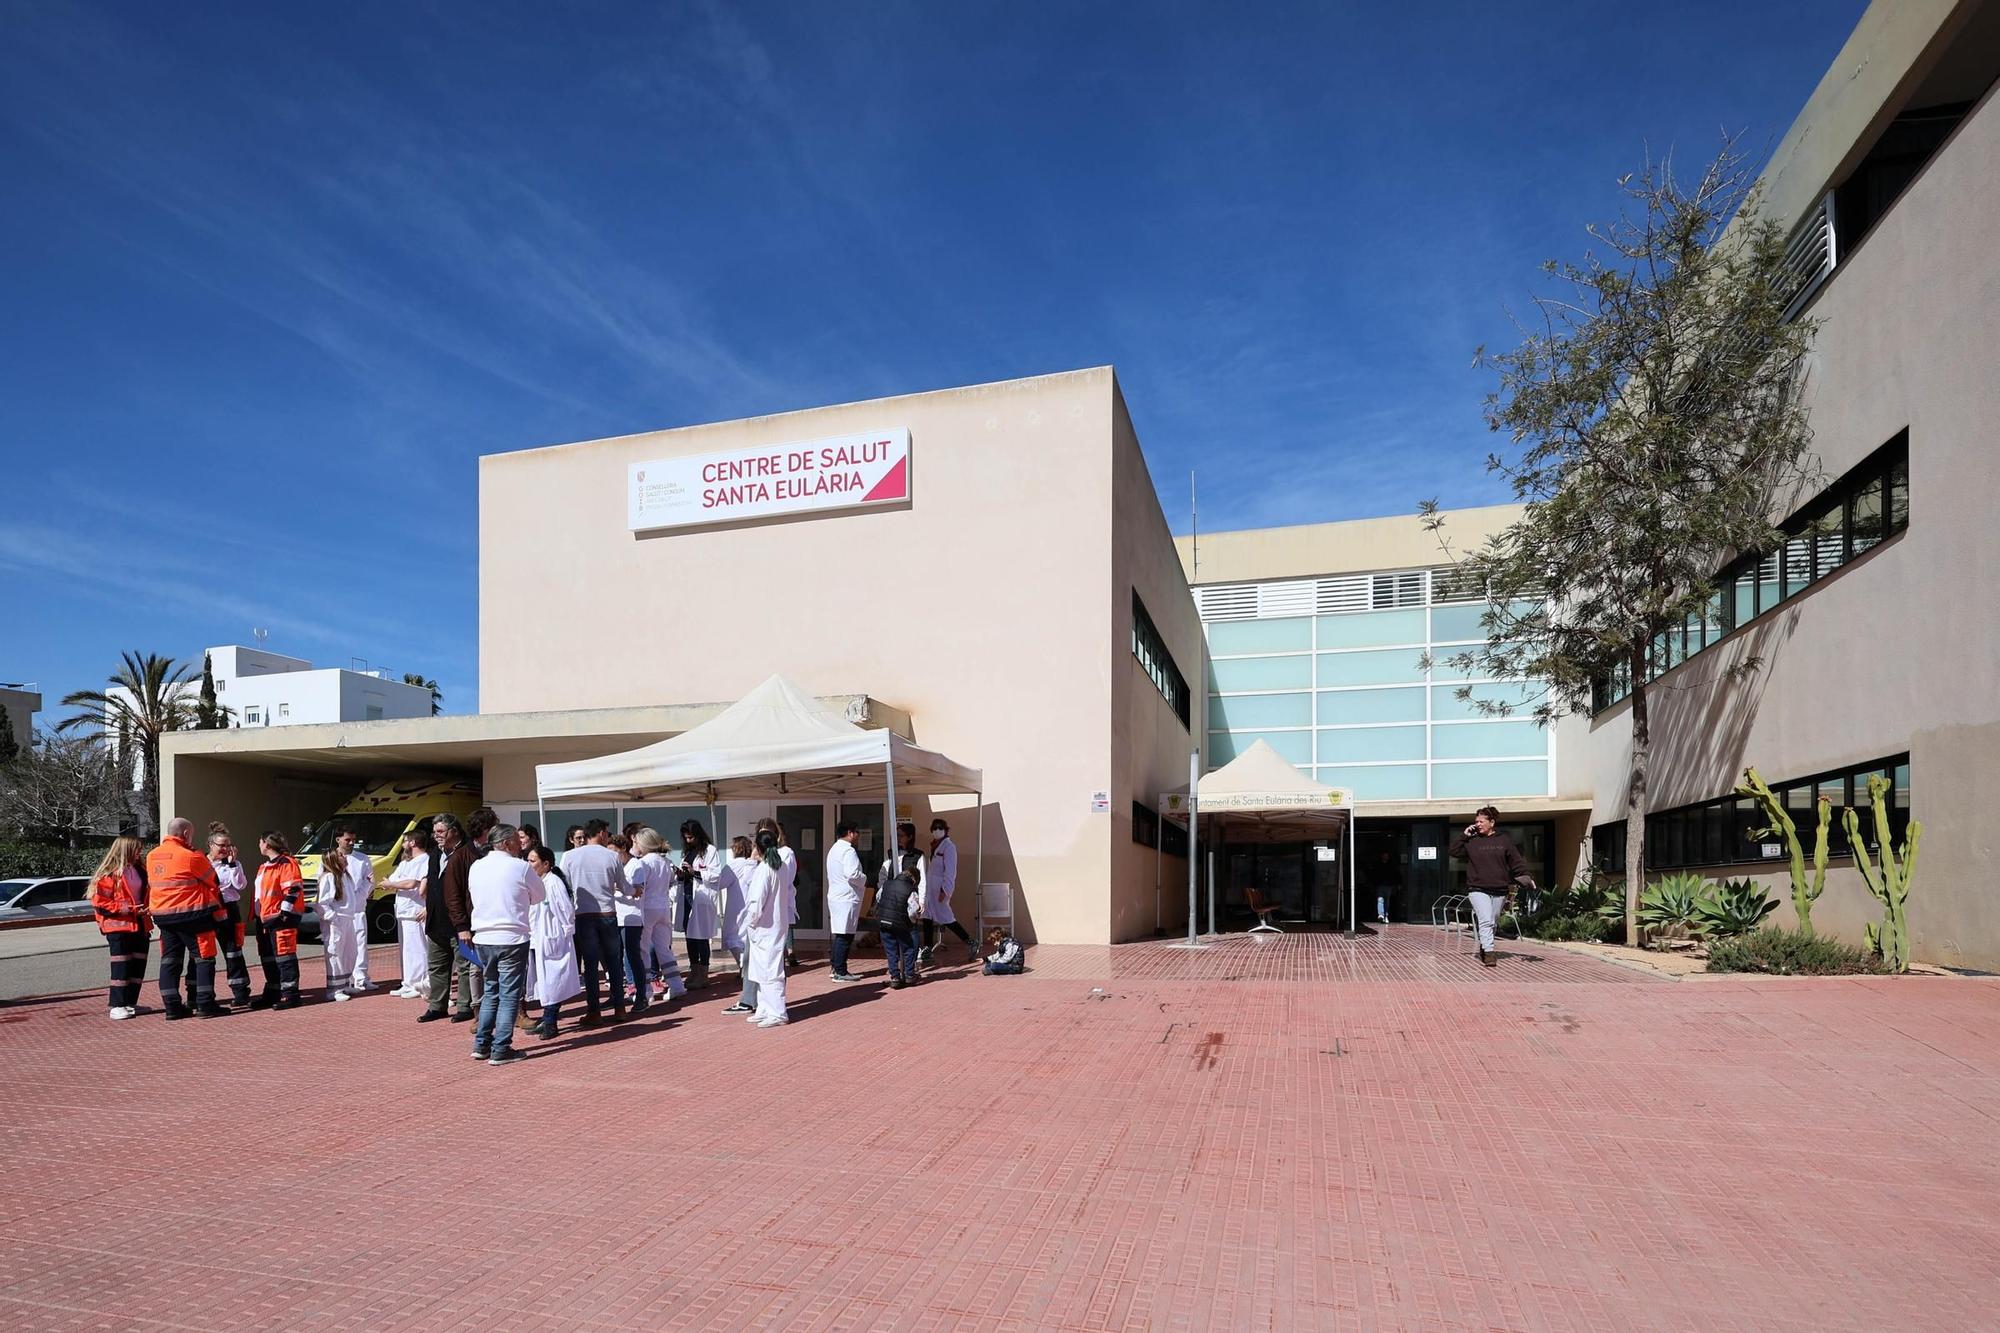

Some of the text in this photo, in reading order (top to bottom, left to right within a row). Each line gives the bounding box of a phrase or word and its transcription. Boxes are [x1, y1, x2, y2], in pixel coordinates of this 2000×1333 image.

[702, 440, 892, 483] CENTRE DE SALUT
[702, 470, 865, 509] SANTA EULÀRIA
[1198, 798, 1229, 807] ntament
[1231, 795, 1241, 806] de
[1242, 795, 1264, 806] Santa
